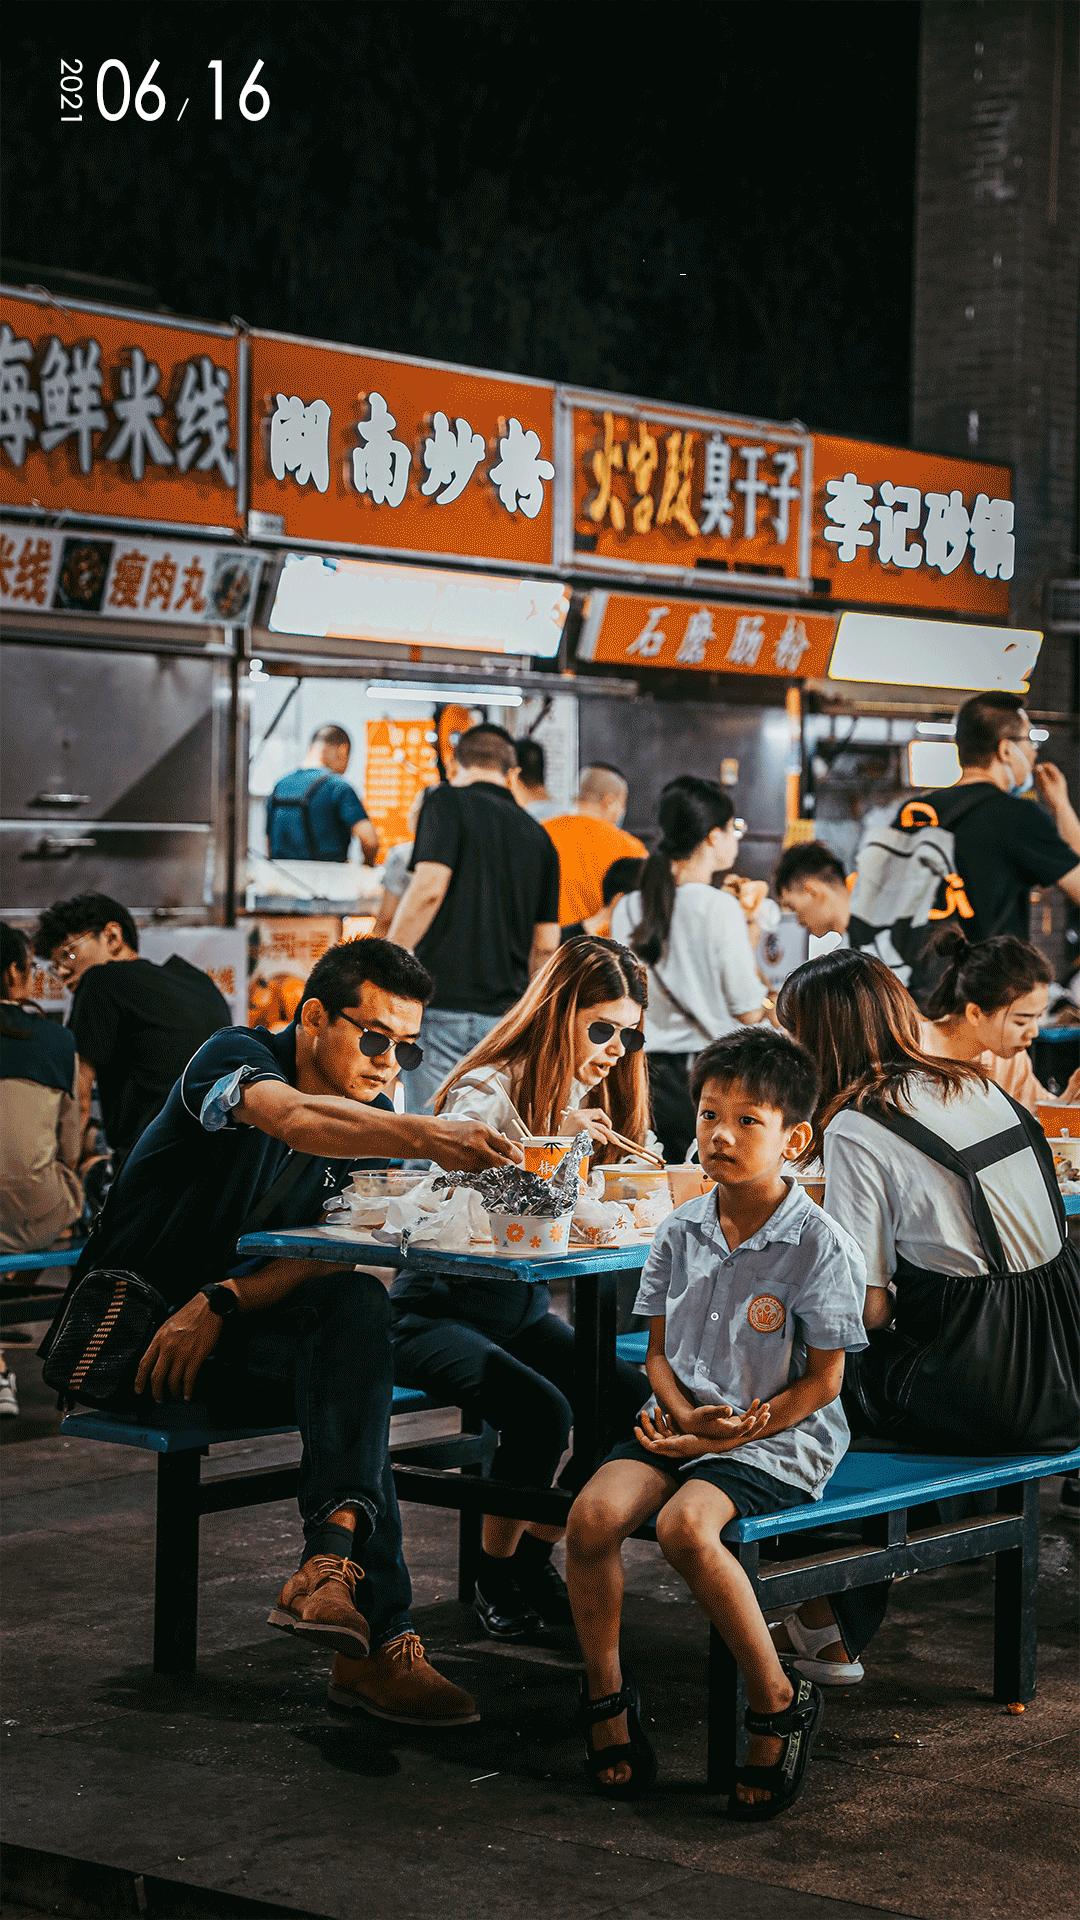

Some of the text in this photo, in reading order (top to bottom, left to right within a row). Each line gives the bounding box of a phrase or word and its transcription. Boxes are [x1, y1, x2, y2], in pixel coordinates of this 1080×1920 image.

[270, 392, 556, 519] 湖南炒粉
[823, 473, 1015, 580] 李记砂锅
[108, 549, 206, 612] 瘦肉丸
[626, 605, 810, 673] 石磨肠粉
